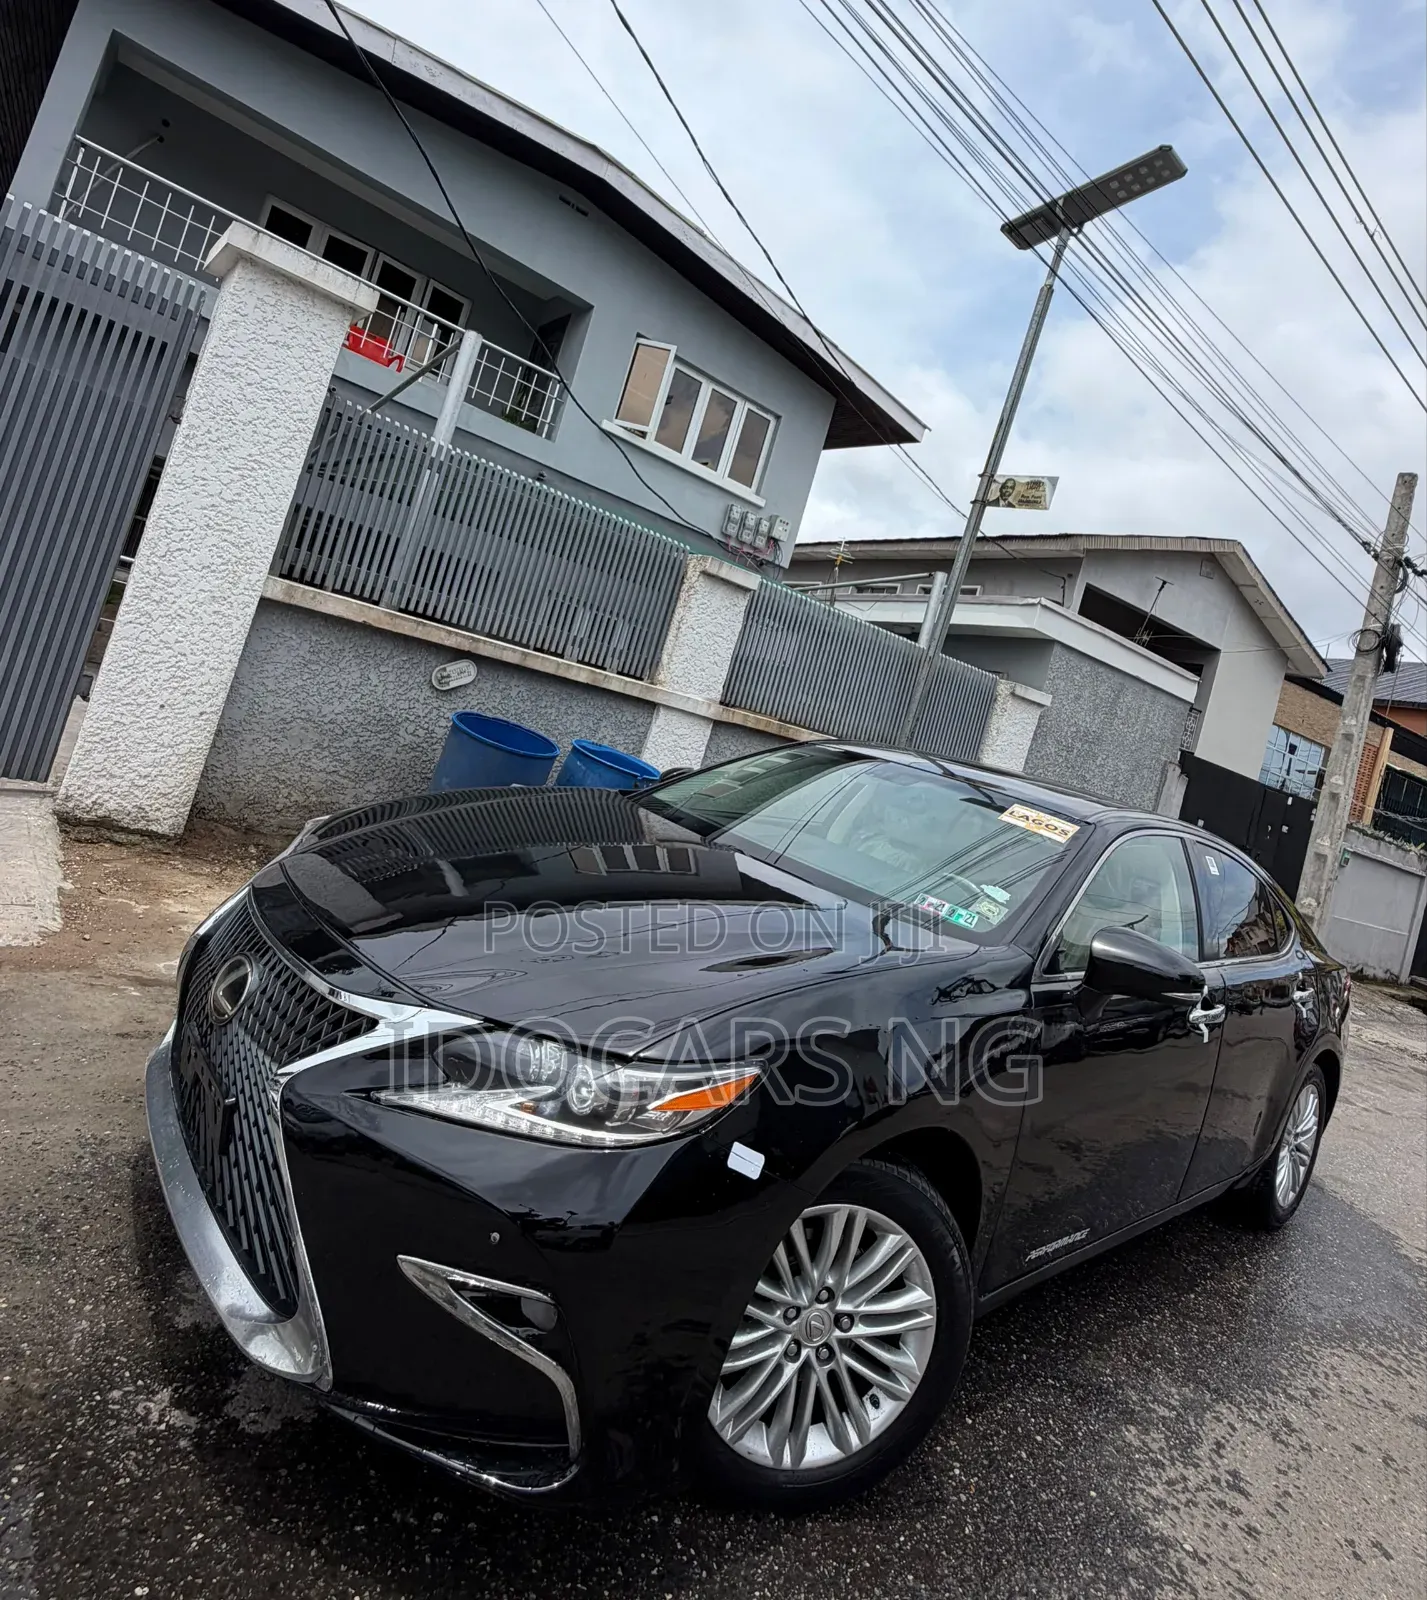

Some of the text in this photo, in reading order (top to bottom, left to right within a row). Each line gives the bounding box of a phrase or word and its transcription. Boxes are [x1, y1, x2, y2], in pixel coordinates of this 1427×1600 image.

[1009, 810, 1070, 836] LAGOS
[947, 907, 956, 918] 2
[964, 912, 976, 926] 21
